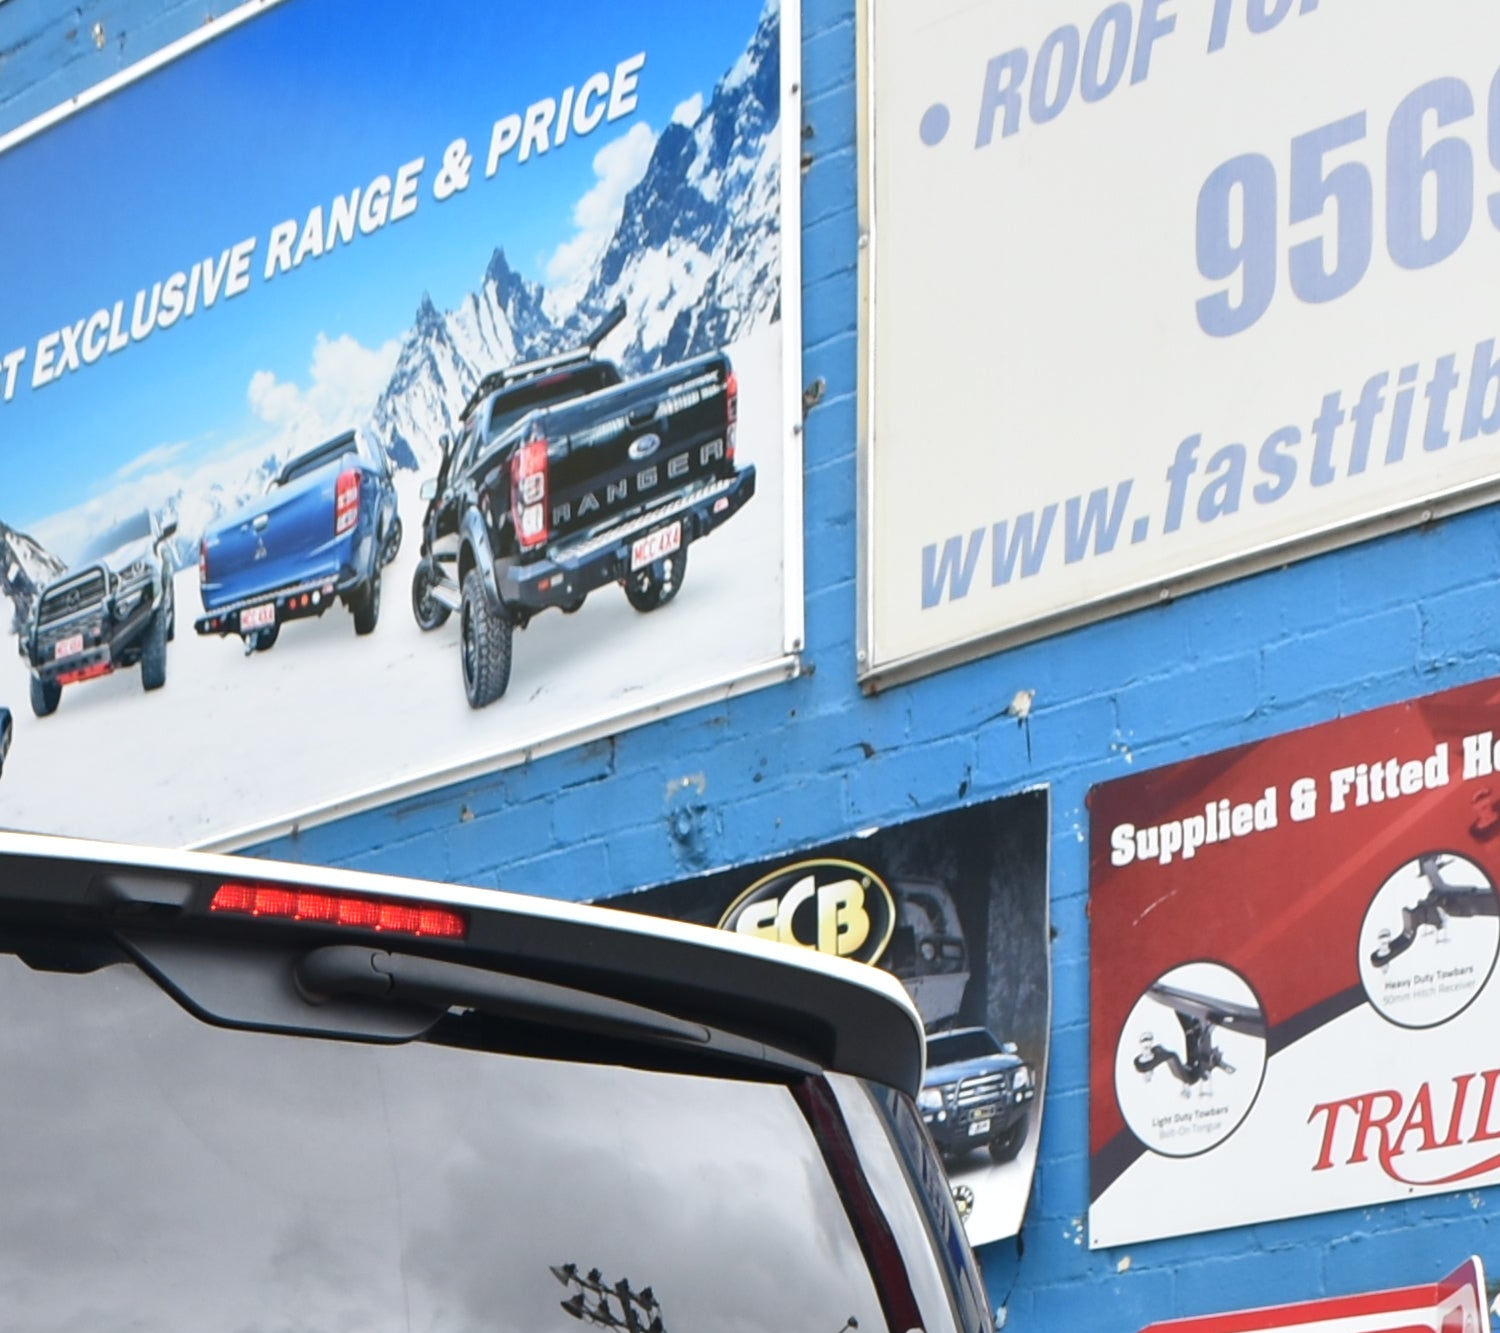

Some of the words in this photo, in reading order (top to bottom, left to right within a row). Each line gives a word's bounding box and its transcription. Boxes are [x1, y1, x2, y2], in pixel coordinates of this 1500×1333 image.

[974, 0, 1178, 149] ROOF
[31, 237, 256, 391] EXCLUSIVE
[264, 157, 427, 282] RANGE
[431, 137, 474, 202] &
[485, 52, 647, 179] PRICE
[552, 437, 724, 527] RANGER
[1110, 786, 1278, 867] Supplied
[1290, 777, 1317, 821] &
[1330, 743, 1449, 813] Fitted
